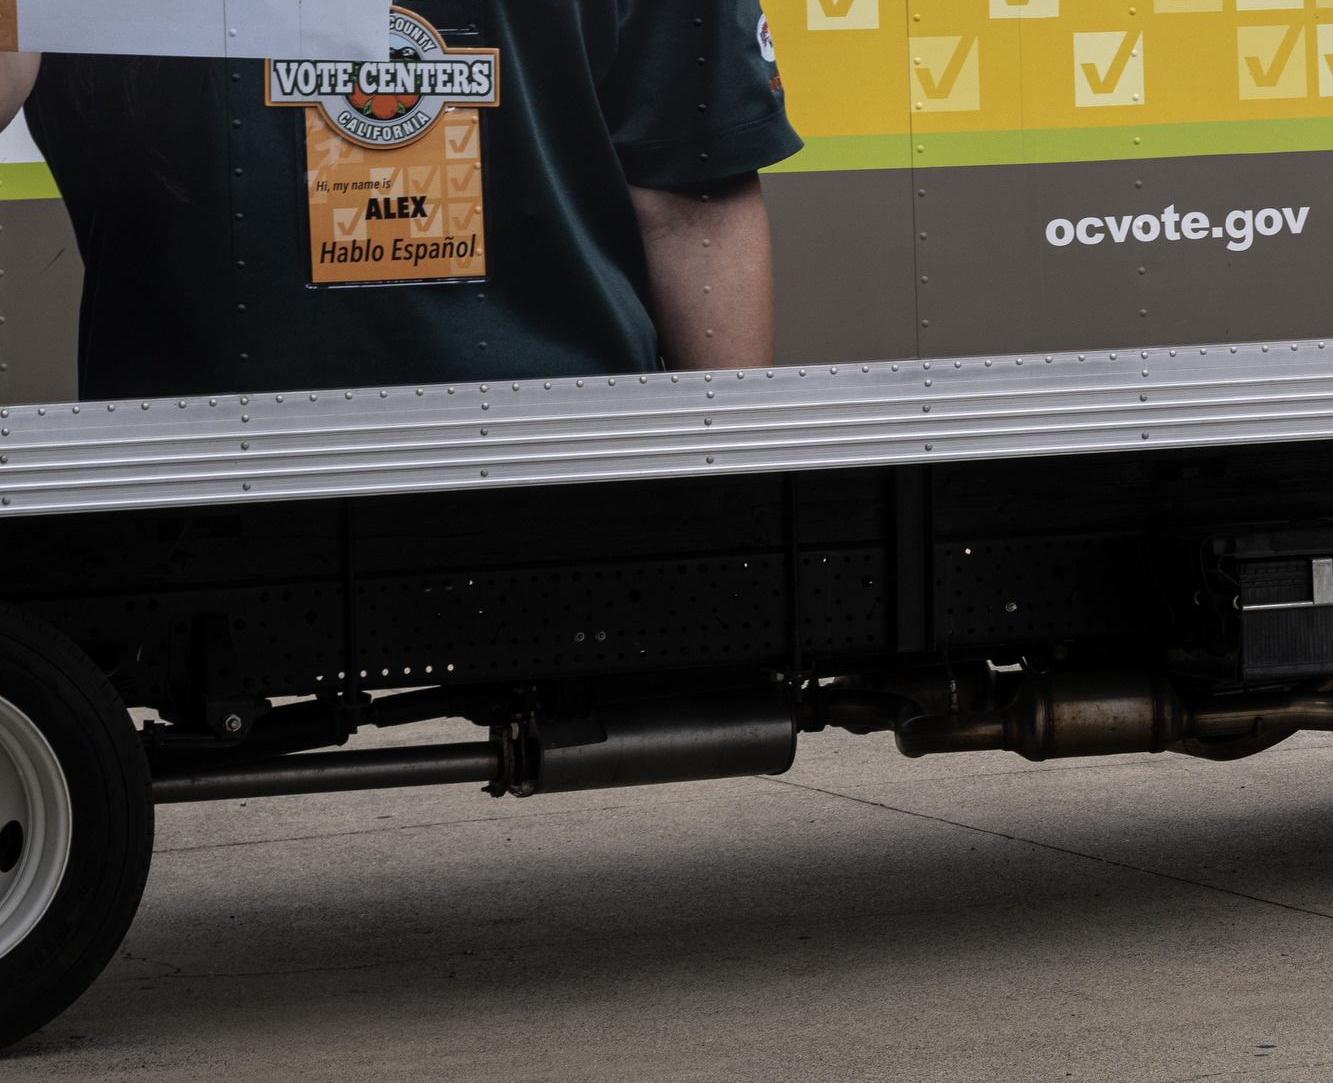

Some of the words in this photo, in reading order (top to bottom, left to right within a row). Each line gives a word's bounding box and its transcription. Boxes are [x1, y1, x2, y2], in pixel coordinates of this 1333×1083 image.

[275, 60, 354, 95] VOTE
[358, 61, 491, 95] CENTERS
[337, 110, 432, 142] CALIFORNIA
[316, 180, 330, 193] Hi,
[332, 182, 349, 194] my
[351, 180, 380, 190] name
[382, 177, 391, 189] is
[365, 196, 428, 220] ALEX
[1045, 204, 1310, 252] ocvote.gov
[320, 238, 384, 264] Hablo
[391, 233, 477, 267] Español
